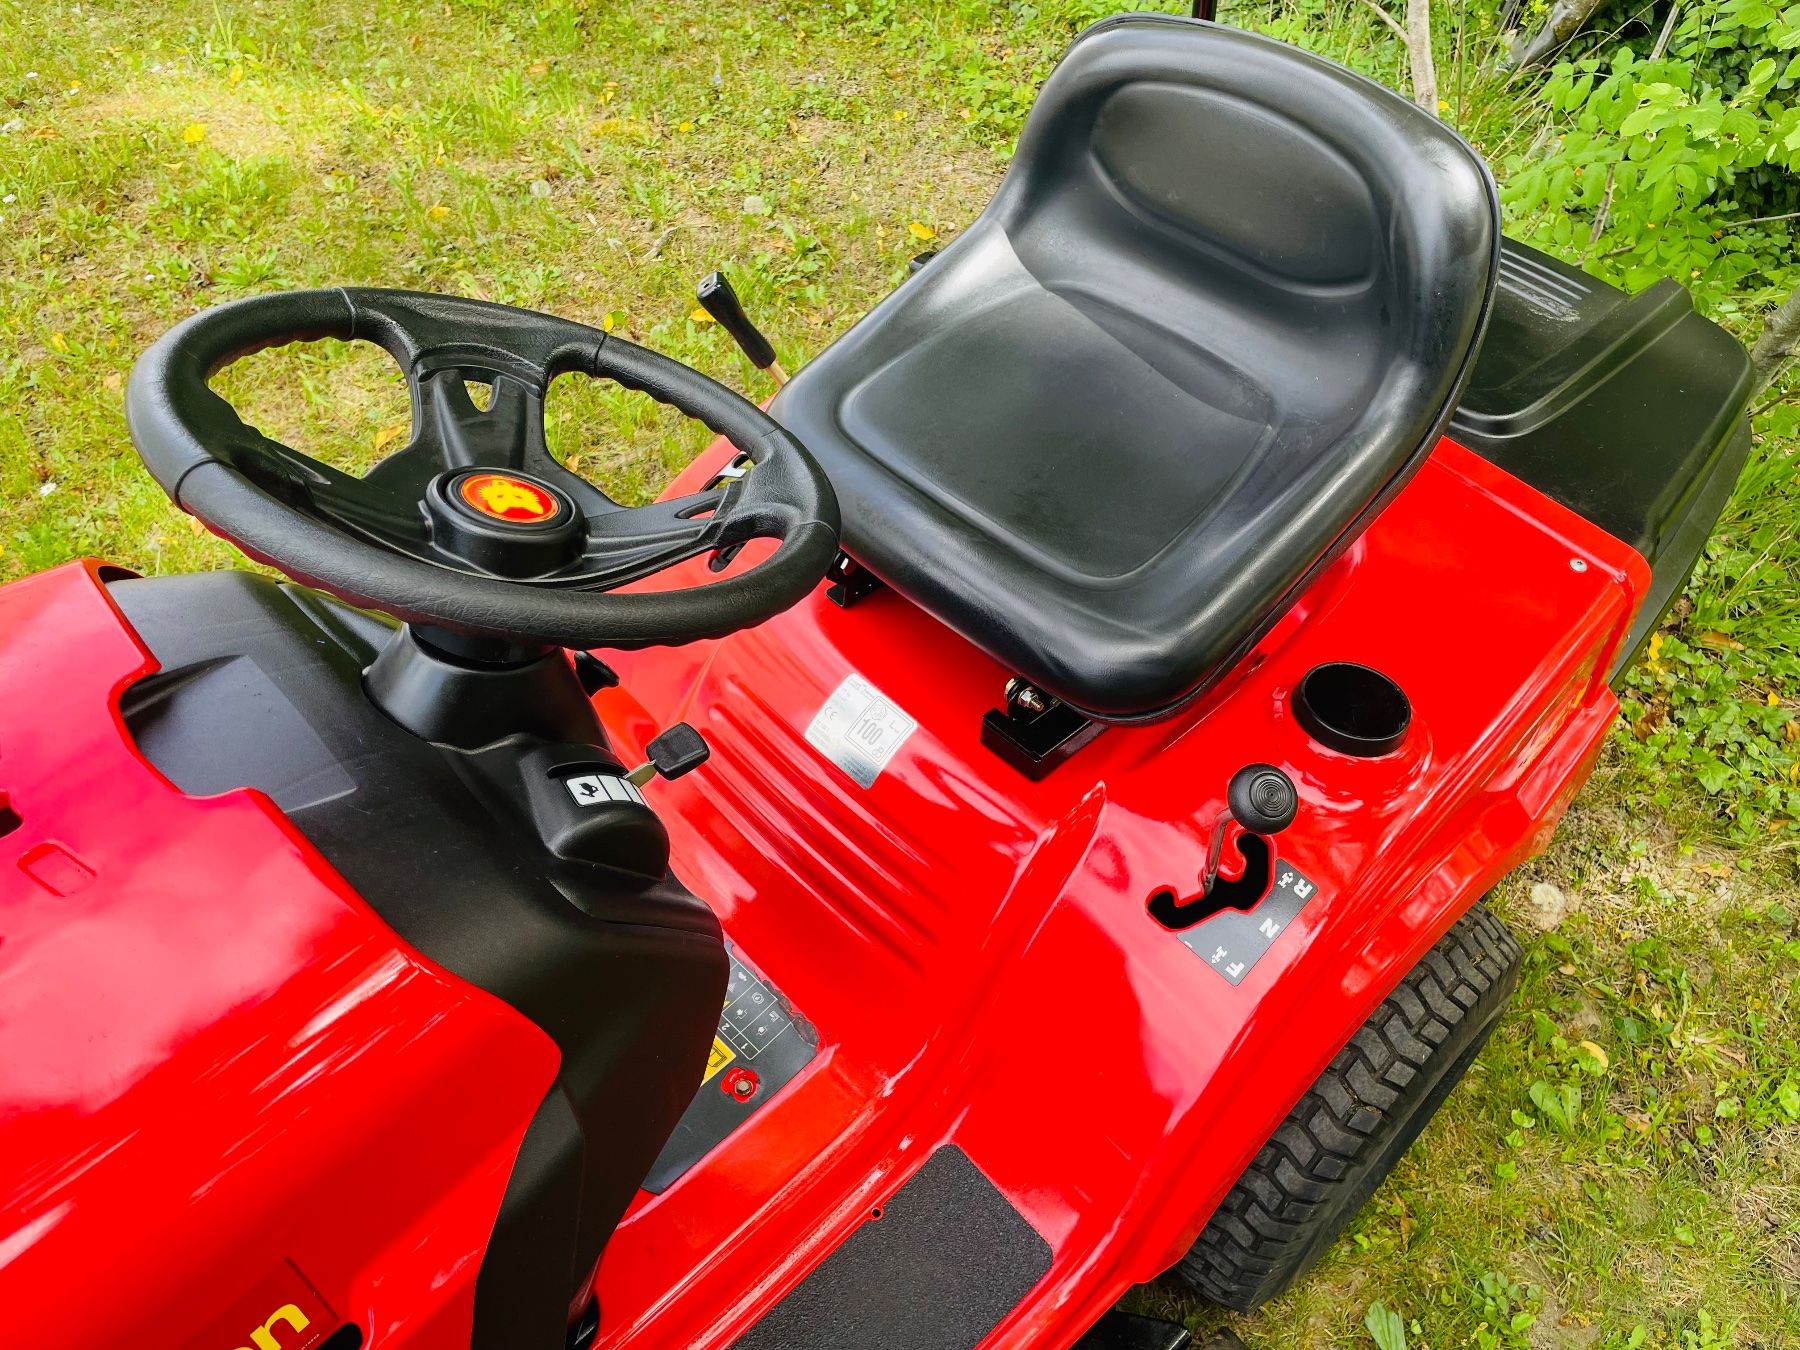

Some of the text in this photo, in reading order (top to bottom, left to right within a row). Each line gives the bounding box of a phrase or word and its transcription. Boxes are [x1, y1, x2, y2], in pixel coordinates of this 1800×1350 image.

[856, 718, 884, 746] 100
[1294, 878, 1313, 899] R
[1258, 918, 1280, 939] N
[1225, 962, 1245, 978] F
[721, 1022, 730, 1031] 2
[740, 1042, 748, 1050] 1
[233, 1303, 310, 1350] n
